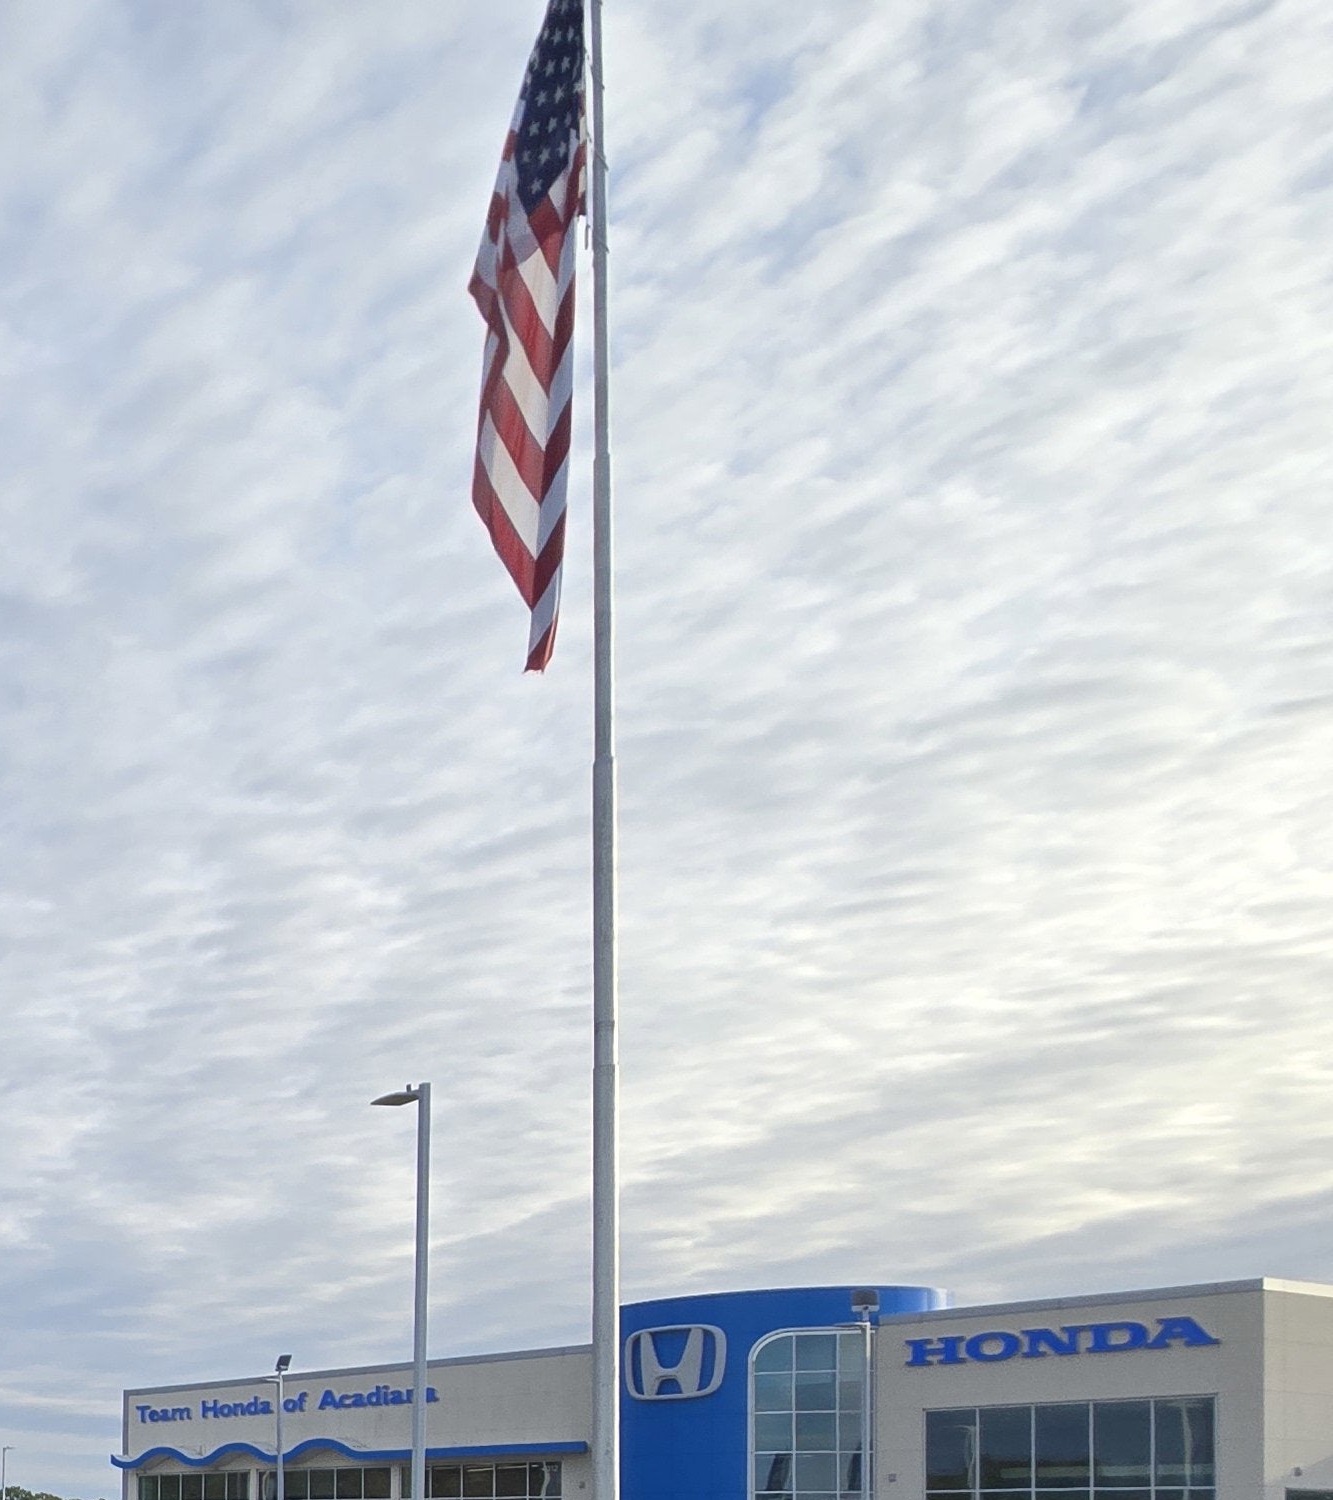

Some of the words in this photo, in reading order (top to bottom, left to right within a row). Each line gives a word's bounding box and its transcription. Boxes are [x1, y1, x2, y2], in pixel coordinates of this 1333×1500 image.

[905, 1316, 1220, 1367] HONDA
[136, 1405, 192, 1424] Team
[201, 1396, 274, 1419] Honda
[283, 1391, 308, 1413] of
